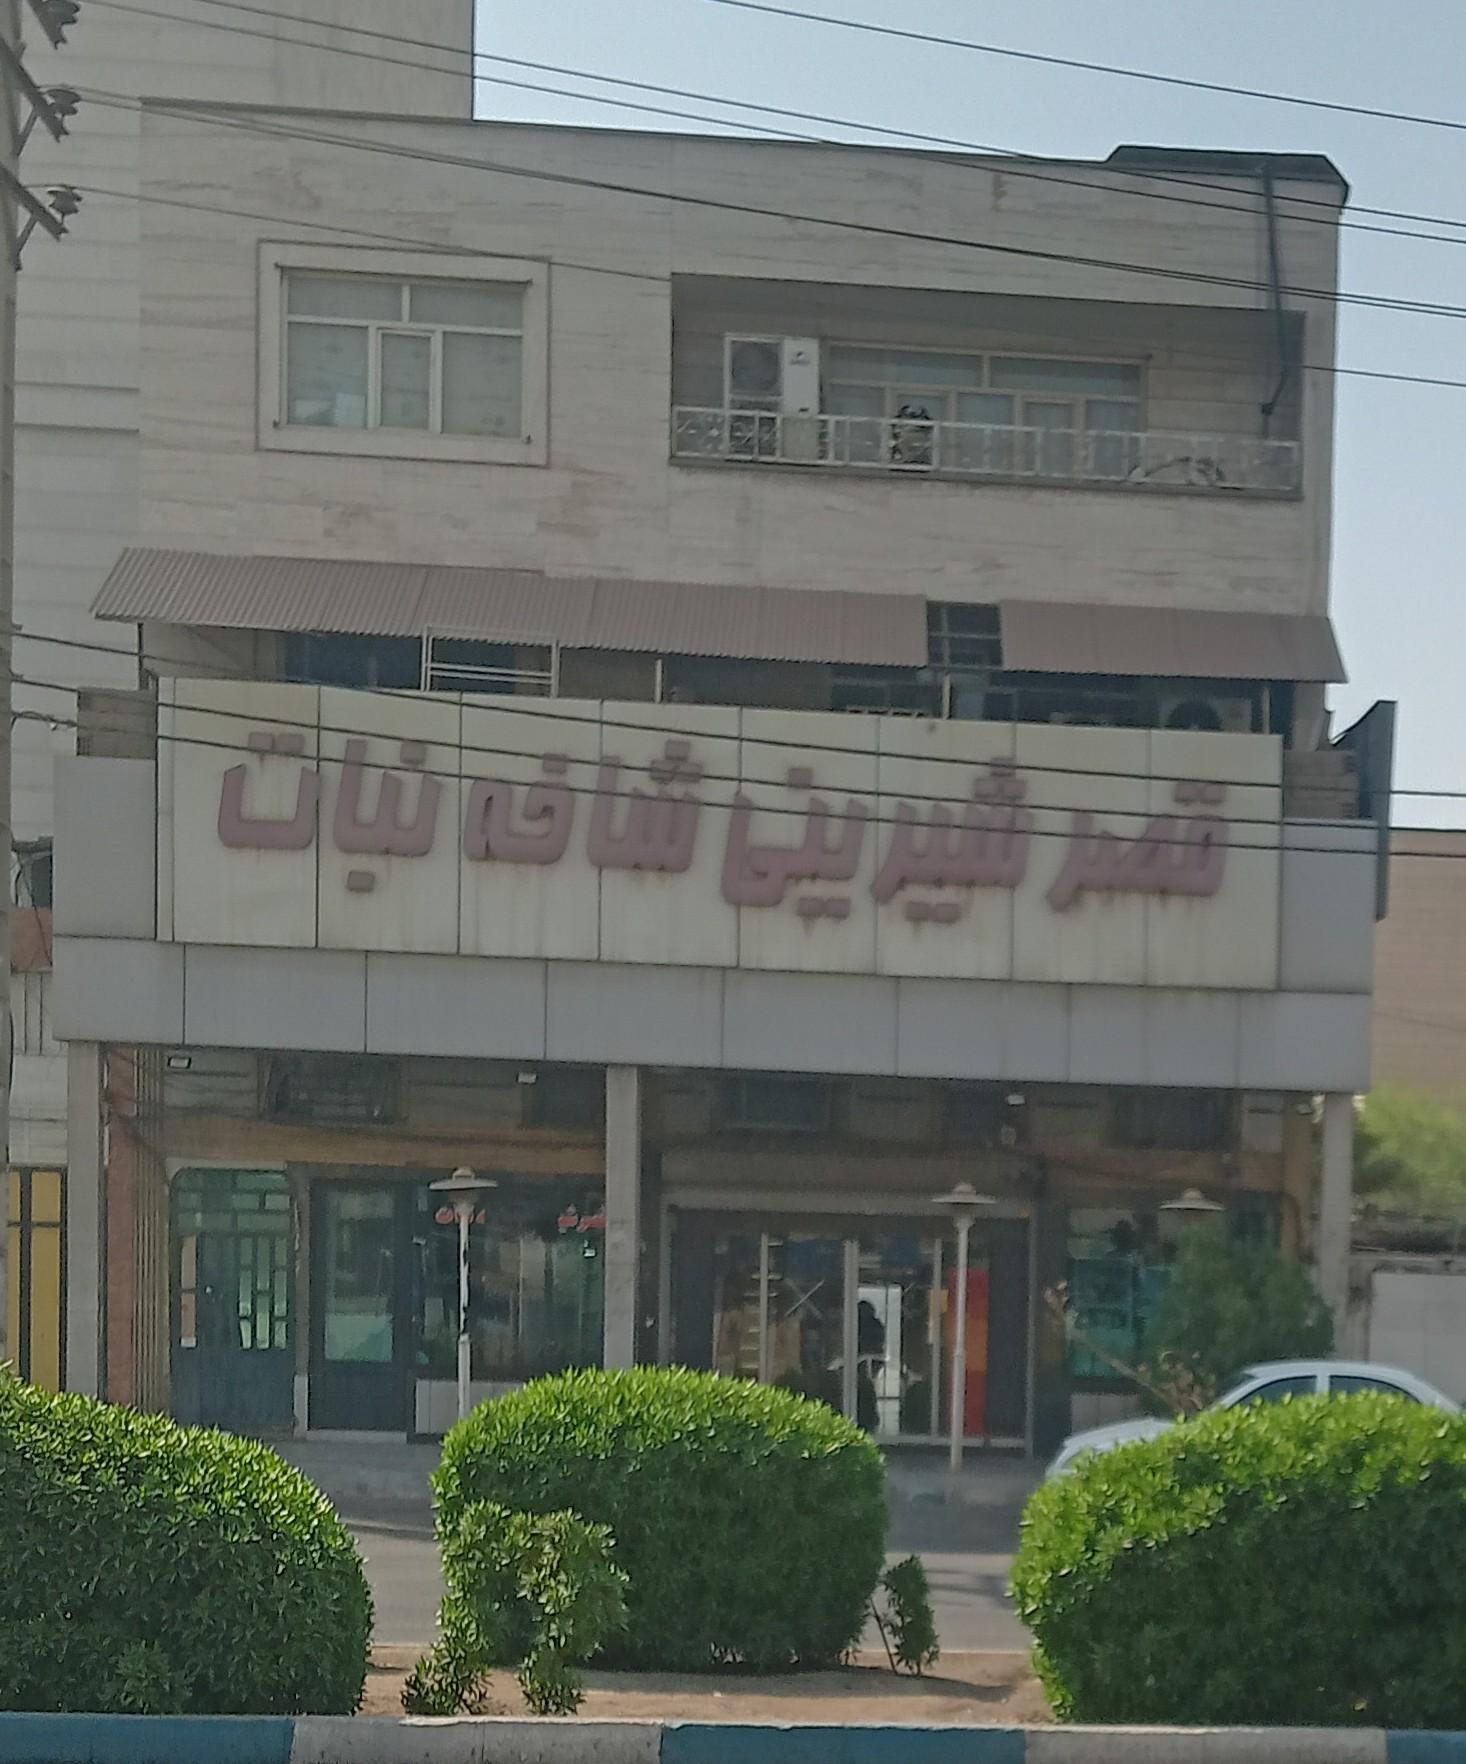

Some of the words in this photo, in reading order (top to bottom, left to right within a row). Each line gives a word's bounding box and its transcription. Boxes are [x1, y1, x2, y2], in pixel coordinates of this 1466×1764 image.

[218, 732, 441, 892] نبات
[466, 741, 704, 873] شاخه
[722, 757, 1032, 923] شیرینی
[1048, 781, 1228, 912] قصر
